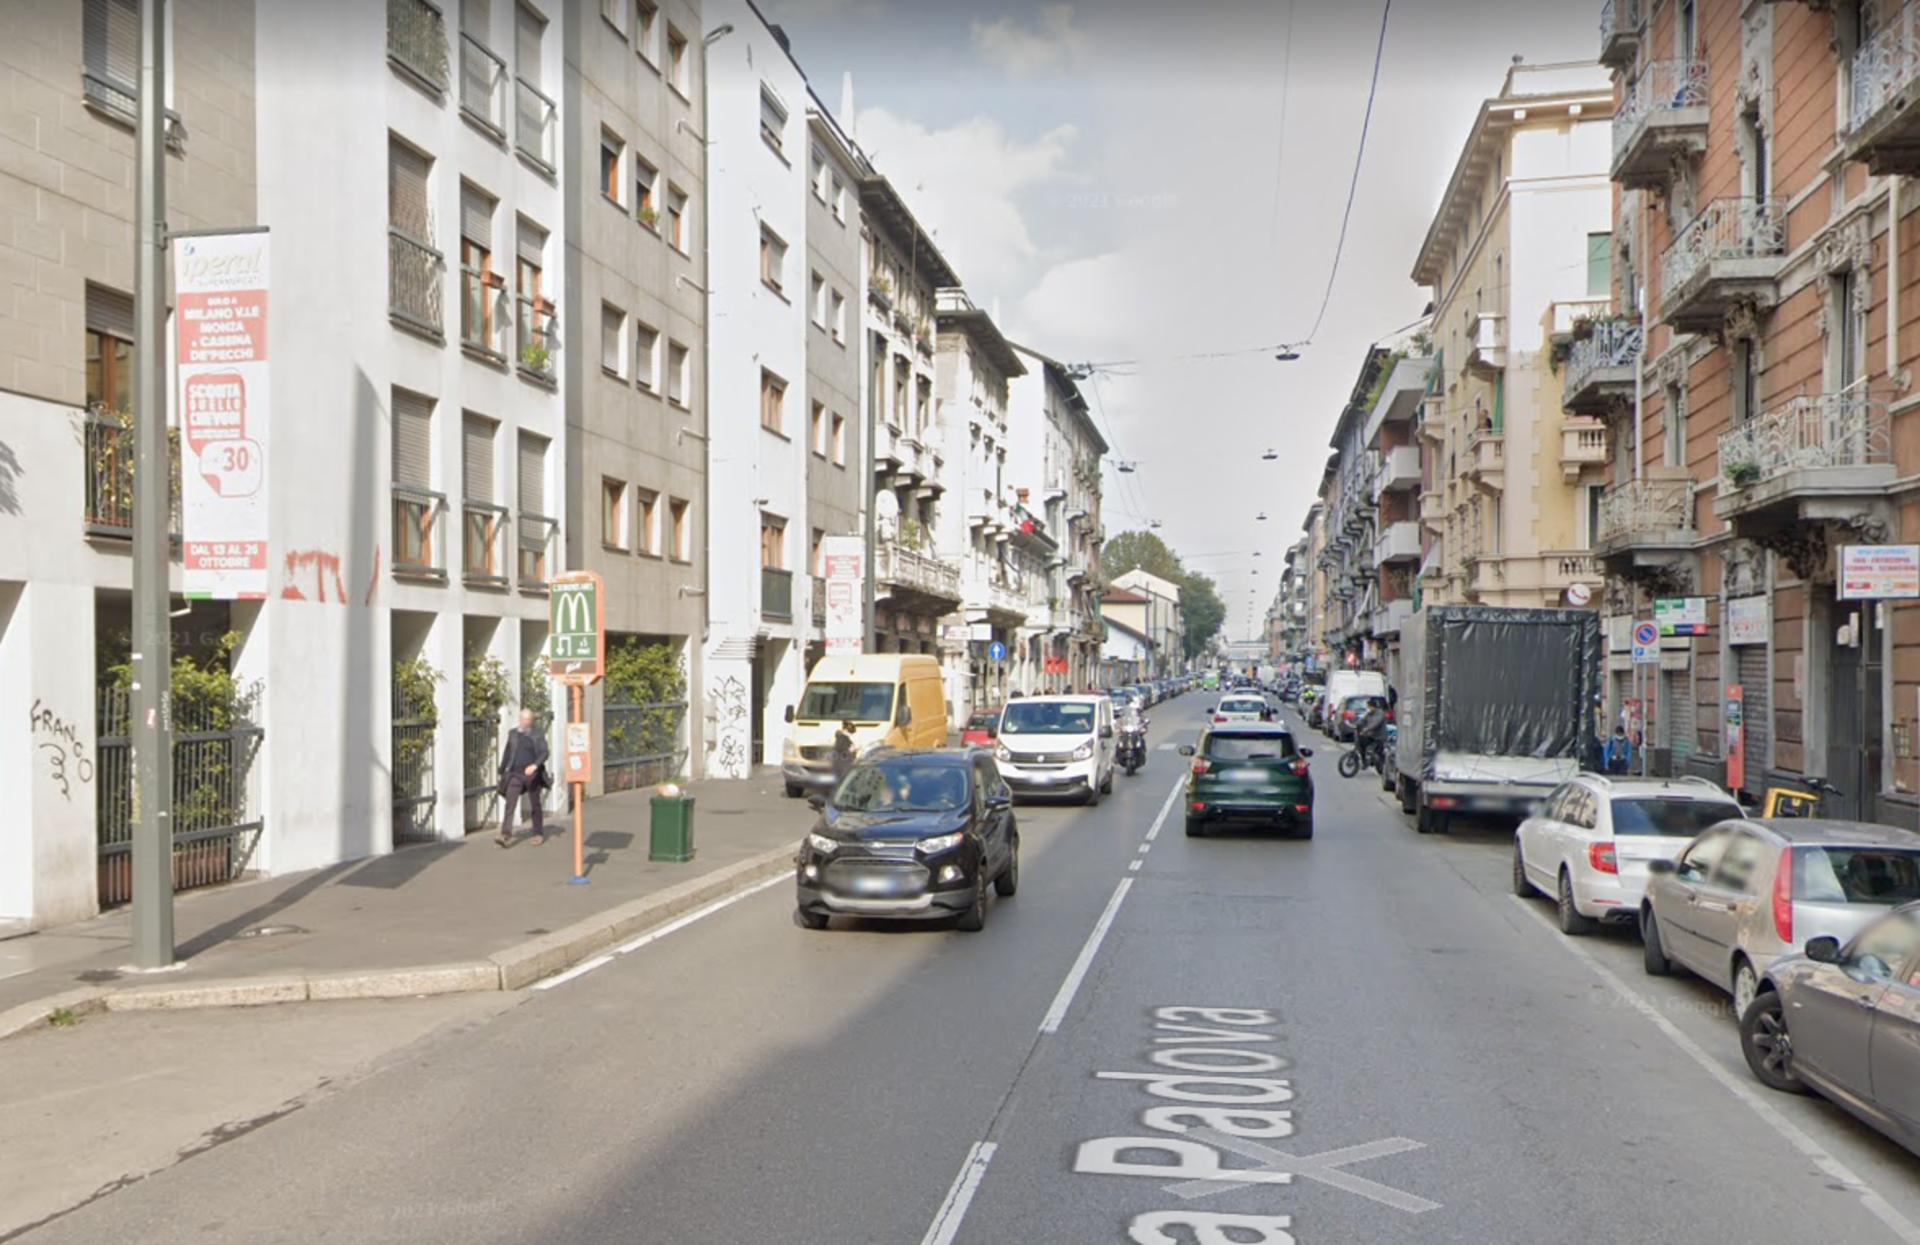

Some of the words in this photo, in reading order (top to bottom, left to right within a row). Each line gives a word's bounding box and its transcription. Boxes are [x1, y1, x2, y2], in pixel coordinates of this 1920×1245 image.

[184, 308, 233, 321] MILANO
[200, 321, 244, 334] MONZA
[223, 446, 249, 472] 30
[190, 544, 210, 556] DAL
[228, 543, 241, 555] AL
[198, 556, 249, 569] OTTOBRE
[30, 699, 93, 783] FRANCO
